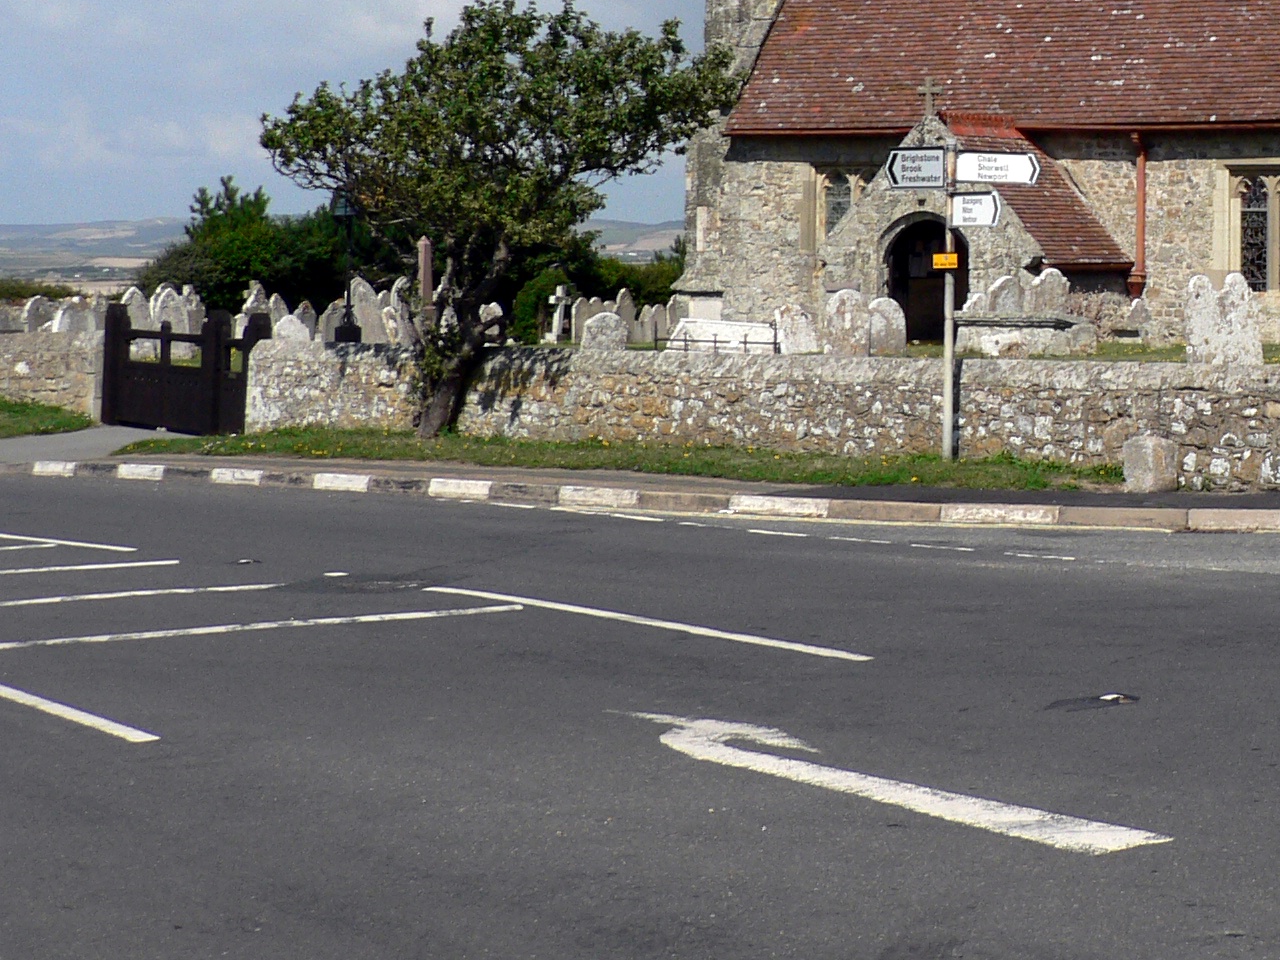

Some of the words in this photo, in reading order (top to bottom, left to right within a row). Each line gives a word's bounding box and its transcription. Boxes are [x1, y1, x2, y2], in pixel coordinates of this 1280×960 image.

[977, 155, 998, 163] Chale
[901, 164, 922, 172] Brook
[978, 163, 1009, 171] Shorwell
[901, 174, 941, 182] Freshwater
[977, 172, 1008, 181] Newport
